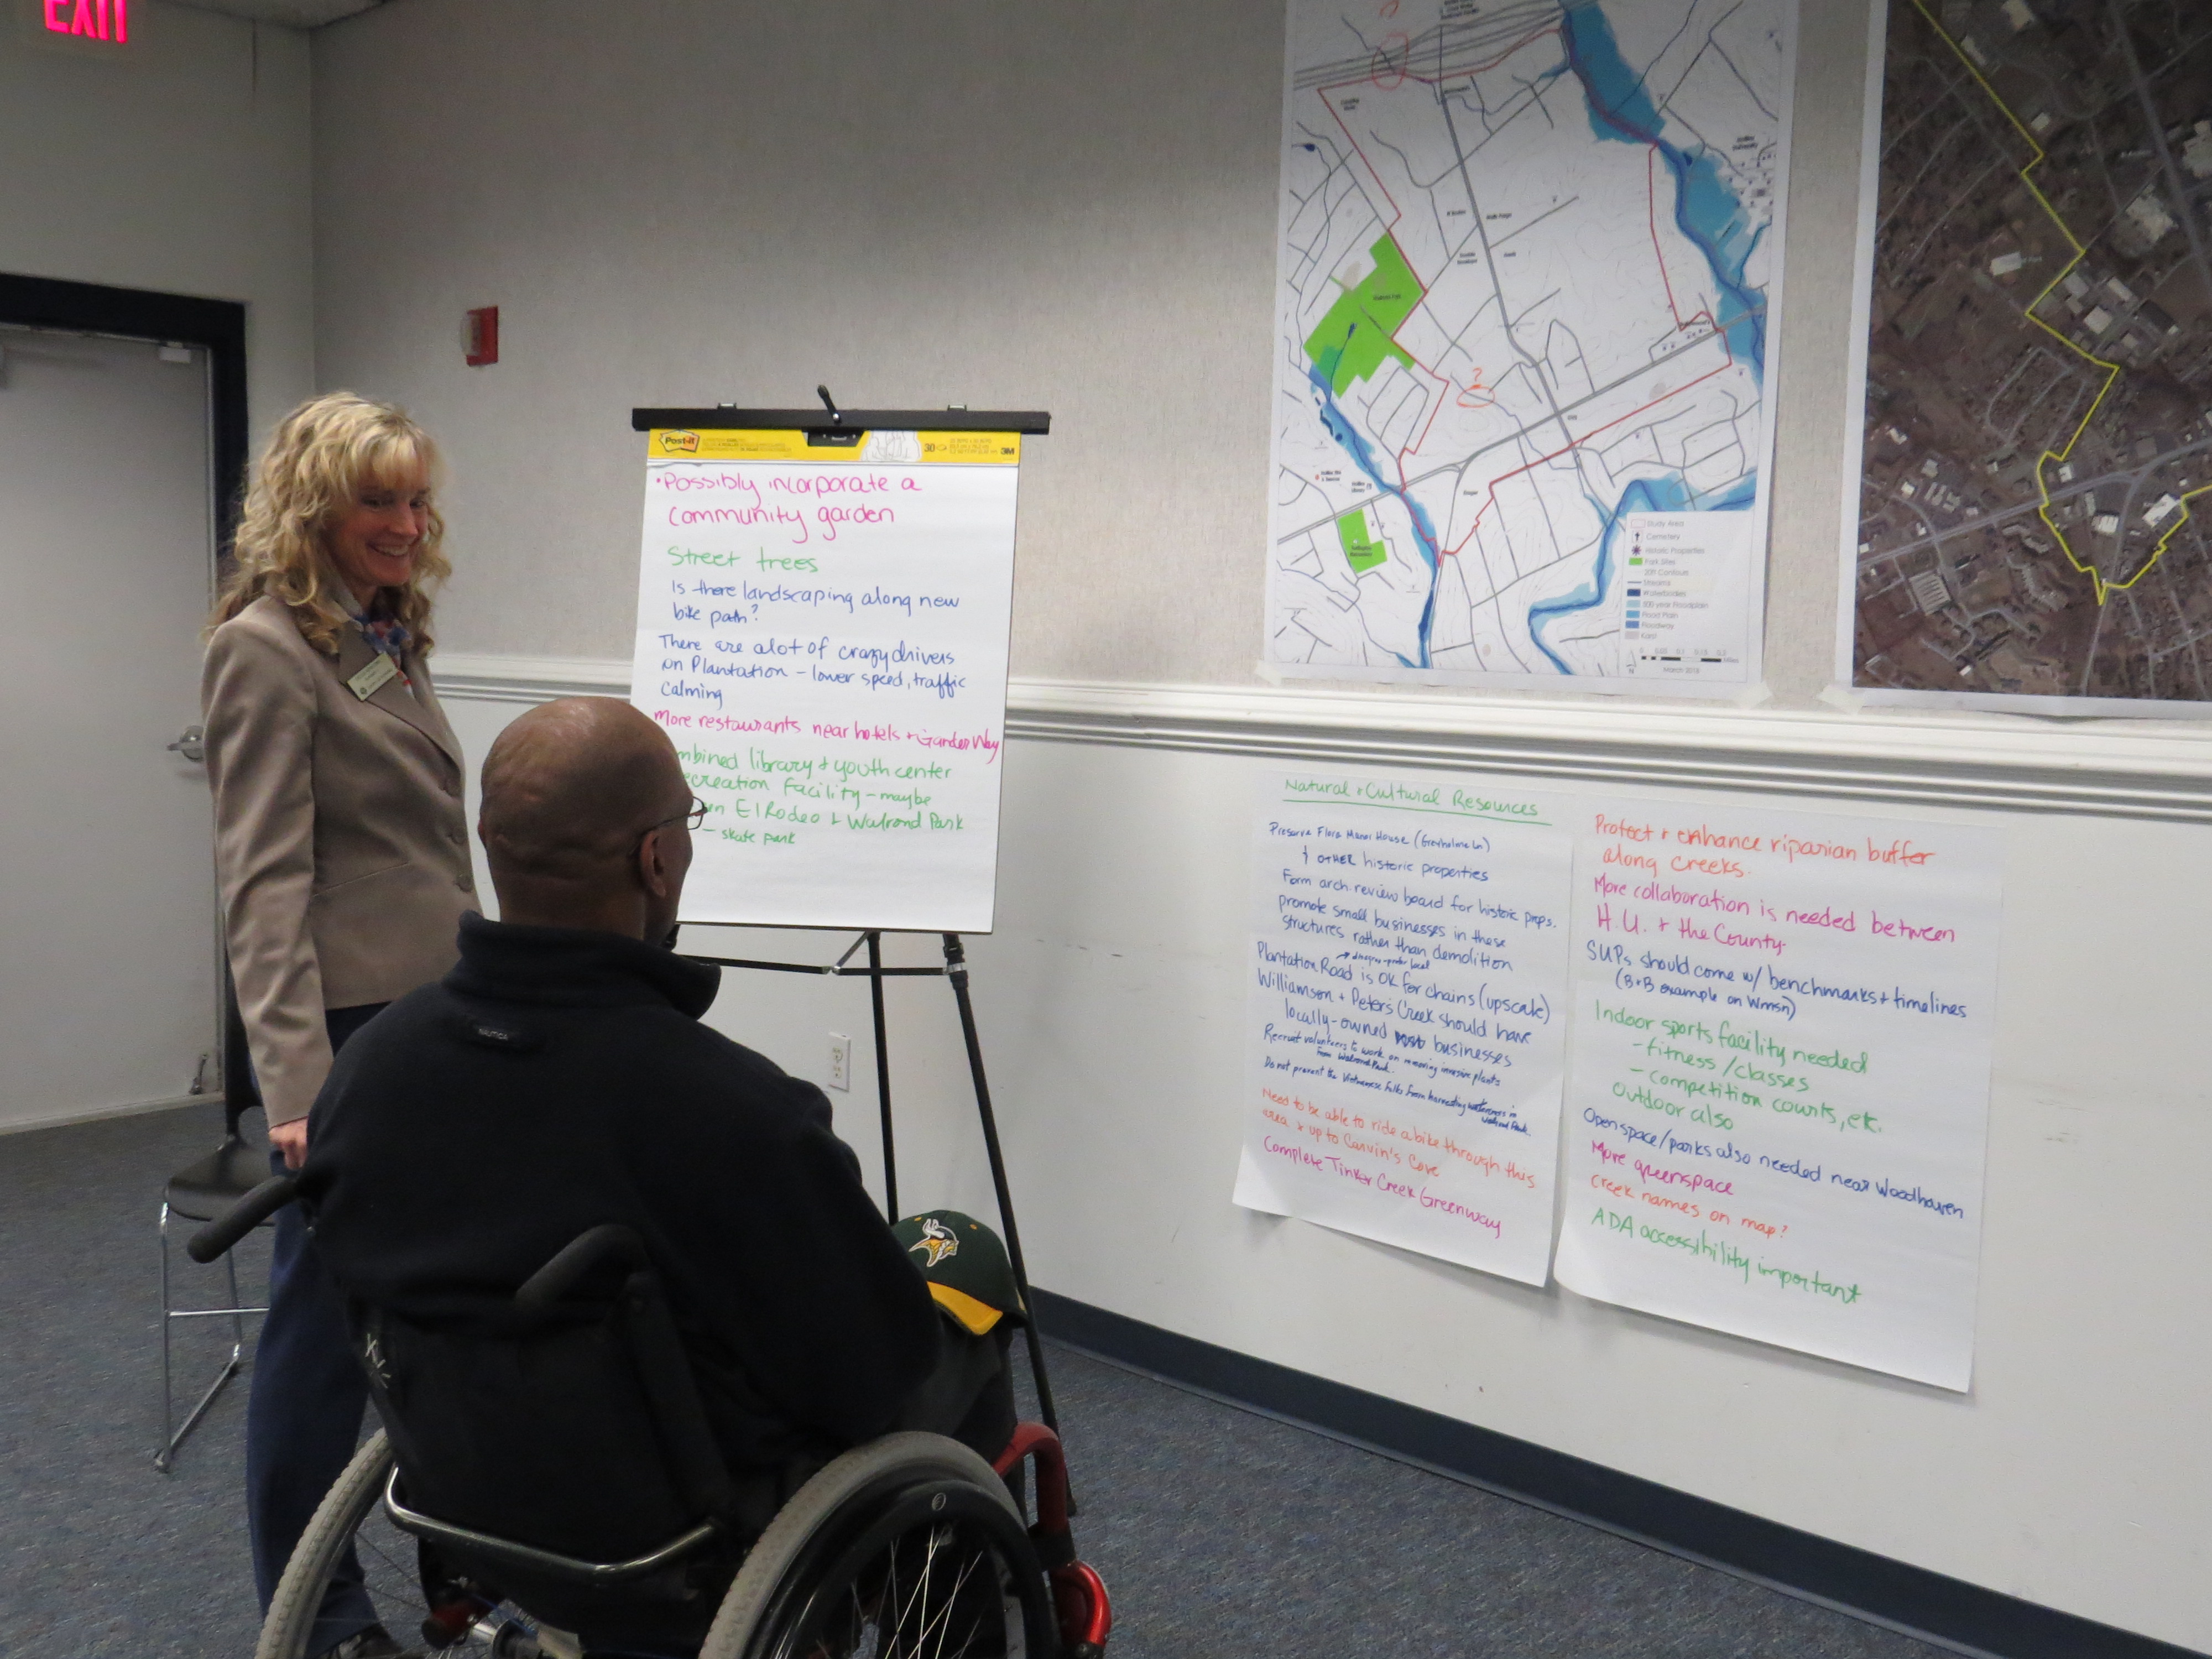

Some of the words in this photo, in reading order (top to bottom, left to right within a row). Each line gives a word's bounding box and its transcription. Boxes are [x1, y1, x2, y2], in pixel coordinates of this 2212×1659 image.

[665, 436, 695, 445] Post-it
[924, 443, 936, 452] 30
[664, 472, 761, 509] Possibly
[769, 473, 889, 498] incorporate
[901, 477, 922, 491] a
[818, 504, 894, 541] garden
[667, 546, 741, 566] Street
[757, 546, 818, 572] trees
[672, 580, 685, 594] Is
[692, 579, 737, 597] there
[744, 580, 853, 614] landscaping
[862, 586, 911, 617] along
[920, 596, 959, 608] new
[674, 602, 701, 620] bike
[658, 634, 702, 650] There
[715, 640, 744, 653] are
[807, 636, 829, 659] of
[838, 645, 888, 672] crazy
[892, 640, 955, 665] drivers
[692, 655, 788, 678] Plantation
[812, 664, 855, 684] lower
[913, 672, 966, 699] traffic
[654, 709, 692, 728] More
[698, 715, 801, 734] restaurants
[813, 723, 849, 739] near
[855, 721, 900, 741] hotels
[973, 728, 999, 764] Way
[750, 747, 813, 779] library
[834, 757, 890, 782] youth
[895, 761, 952, 779] center
[765, 801, 820, 823] Rodeo
[930, 812, 963, 830] Park
[881, 787, 932, 809] maybe
[1285, 779, 1350, 796] Natural
[1366, 782, 1439, 805] Cultural
[1453, 790, 1538, 816] Resources
[722, 828, 756, 843] skate
[764, 831, 795, 845] park
[1269, 821, 1311, 836] Preserve
[1376, 831, 1410, 844] House
[1596, 814, 1654, 842] Protect
[1677, 824, 1762, 851] enhance
[1771, 834, 1857, 863] riparian
[1867, 837, 1936, 867] buffer
[1364, 851, 1413, 872] historic
[1422, 863, 1489, 881] properties
[1603, 843, 1657, 878] along
[1283, 868, 1311, 885] Form
[1355, 884, 1398, 902] review
[1404, 886, 1443, 909] board
[1451, 895, 1474, 912] for
[1479, 898, 1519, 921] historic
[1594, 872, 1627, 898] More
[1634, 881, 1750, 915] collaboration
[1760, 899, 1777, 922] is
[1786, 906, 1856, 932] needed
[1871, 910, 1955, 942] between
[1333, 905, 1368, 923] small
[1375, 909, 1446, 937] businesses
[1454, 926, 1467, 941] in
[1472, 930, 1506, 947] these
[1679, 917, 1710, 940] the
[1354, 931, 1389, 948] rather
[1395, 936, 1426, 957] than
[1433, 944, 1513, 971] demolition
[1258, 941, 1318, 972] Plantation
[1321, 957, 1352, 981] Road
[1361, 967, 1373, 984] is
[1403, 971, 1422, 994] for
[1425, 983, 1475, 1006] chains
[1479, 983, 1550, 1024] (upscale)
[1587, 940, 1632, 966] SUPs
[1640, 951, 1689, 975] should
[1694, 965, 1735, 982] come
[1768, 964, 1877, 1004] benchmarks
[1893, 986, 1967, 1018] timelines
[1660, 983, 1717, 1003] example
[1728, 996, 1742, 1007] on
[1258, 968, 1334, 1002] Williamson
[1398, 999, 1434, 1023] Creek
[1439, 1013, 1488, 1037] should
[1497, 1023, 1532, 1044] have
[1264, 1023, 1301, 1044] Recruit
[1304, 1031, 1347, 1051] volunteers
[1351, 1040, 1358, 1052] to
[1472, 1069, 1501, 1087] plants
[1434, 1035, 1512, 1067] businesses
[1596, 999, 1655, 1030] Indoor
[1661, 1020, 1713, 1044] sports
[1718, 1020, 1785, 1067] facility
[1793, 1049, 1868, 1073] needed
[1277, 1059, 1291, 1071] not
[1428, 1089, 1467, 1117] harvesting
[1613, 1082, 1686, 1117] Outdoor
[1691, 1104, 1734, 1130] also
[1262, 1088, 1289, 1106] Need
[1293, 1097, 1305, 1111] to
[1309, 1101, 1321, 1118] be
[1325, 1108, 1349, 1126] able
[1353, 1114, 1364, 1128] to
[1371, 1120, 1396, 1135] ride
[1413, 1126, 1439, 1147] bike
[1443, 1137, 1500, 1176] through
[1505, 1161, 1536, 1188] this
[1262, 1108, 1290, 1127] area
[1309, 1125, 1322, 1142] up
[1327, 1128, 1339, 1145] to
[1409, 1154, 1439, 1177] Cove
[1264, 1135, 1323, 1171] Complete
[1324, 1156, 1373, 1186] Tinker
[1377, 1172, 1416, 1198] Creek
[1420, 1187, 1501, 1239] Greenway
[1592, 1140, 1626, 1165] More
[1634, 1159, 1734, 1196] greenspace
[1717, 1142, 1751, 1164] also
[1760, 1155, 1821, 1182] needed
[1832, 1173, 1869, 1192] near
[1876, 1178, 1963, 1218] Woodhaven
[1642, 1192, 1700, 1218] names
[1709, 1209, 1731, 1225] on
[1741, 1217, 1788, 1239] map?
[1592, 1207, 1634, 1239] ADA
[1640, 1229, 1749, 1285] accessibility
[1759, 1257, 1862, 1304] important
